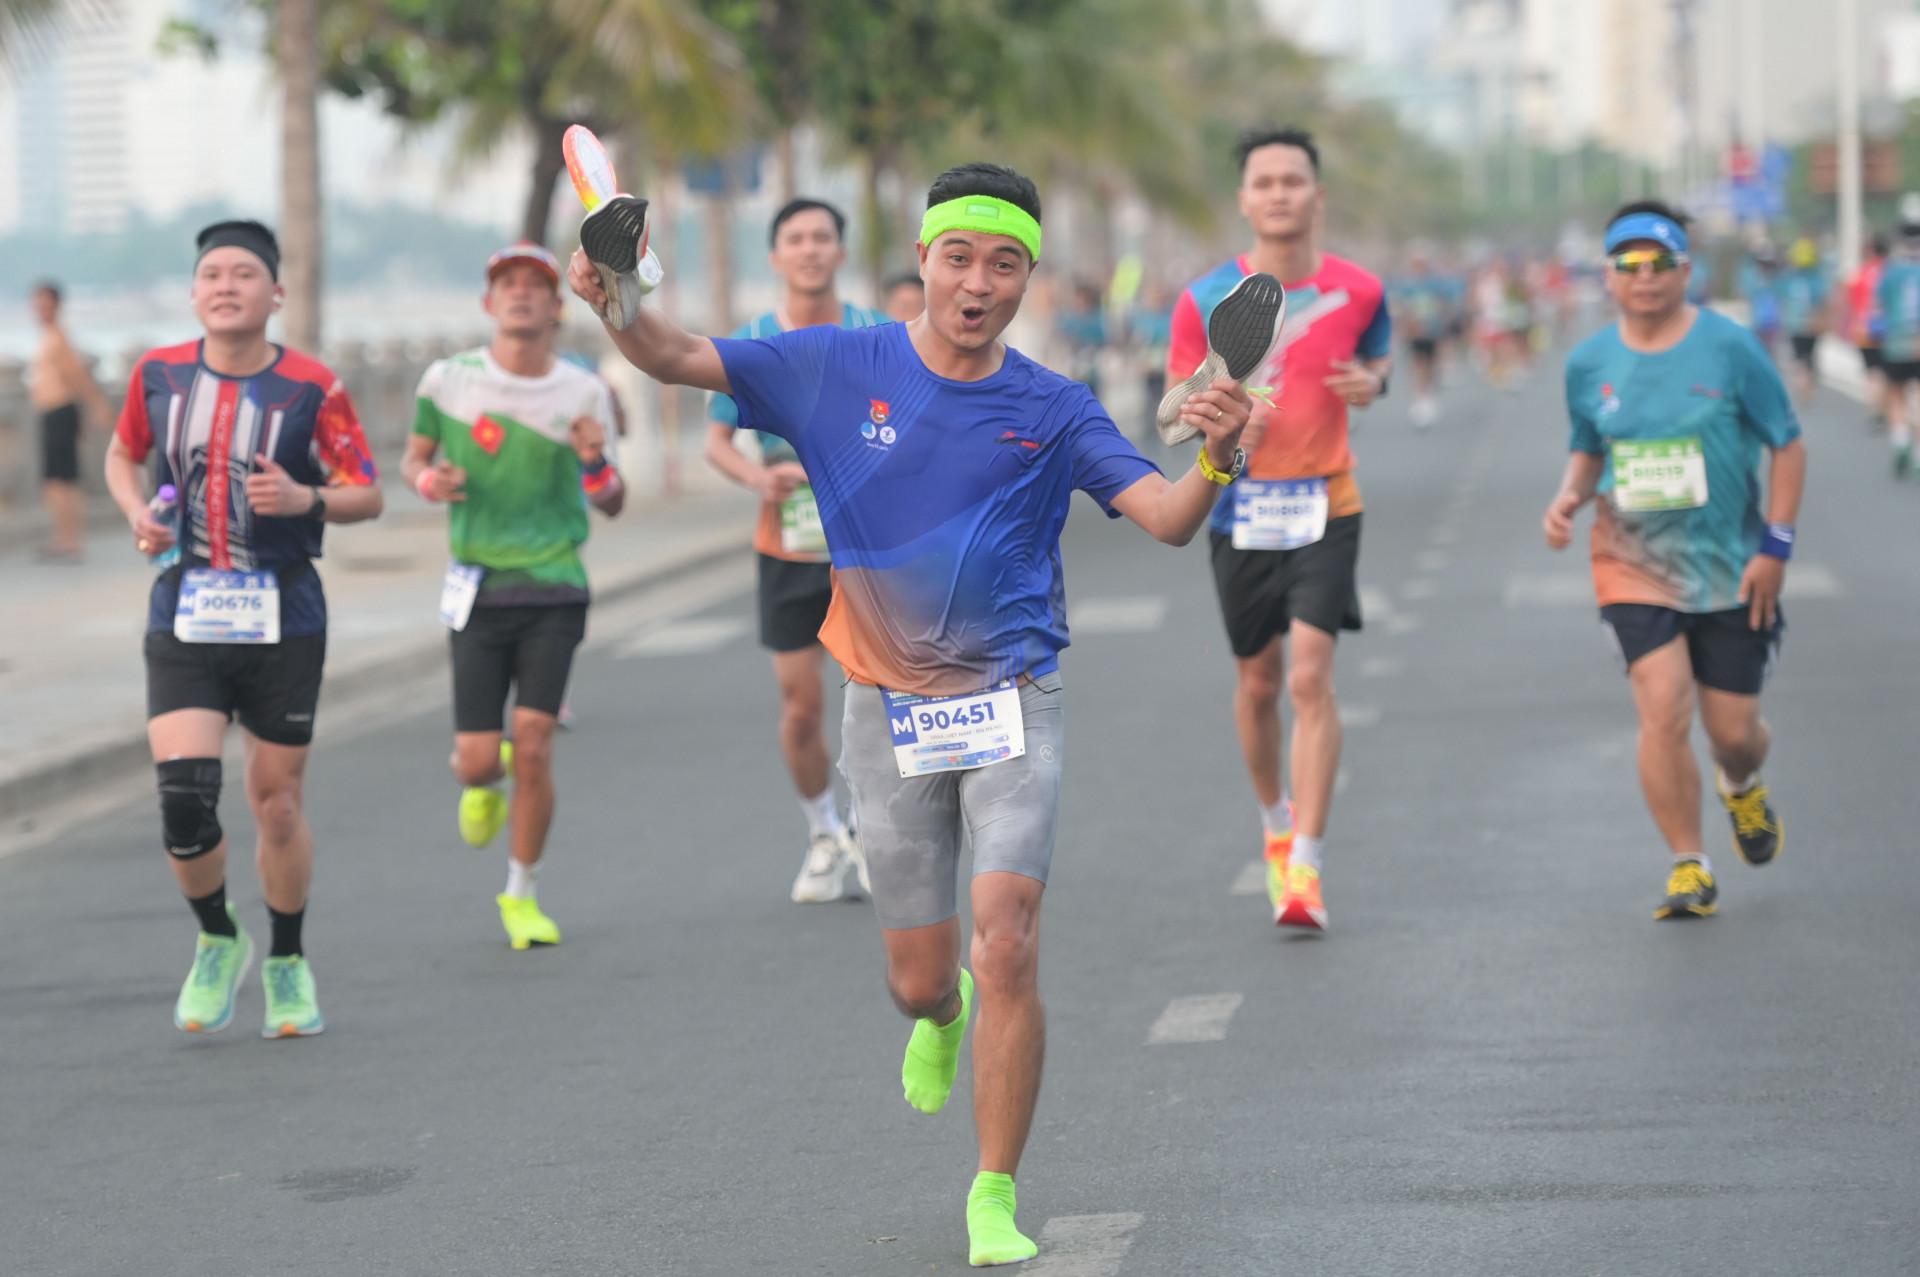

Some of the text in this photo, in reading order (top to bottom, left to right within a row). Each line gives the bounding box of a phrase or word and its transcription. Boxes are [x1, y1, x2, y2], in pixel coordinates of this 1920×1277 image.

[199, 594, 263, 611] 90676
[891, 716, 913, 736] M
[918, 701, 996, 732] 90451
